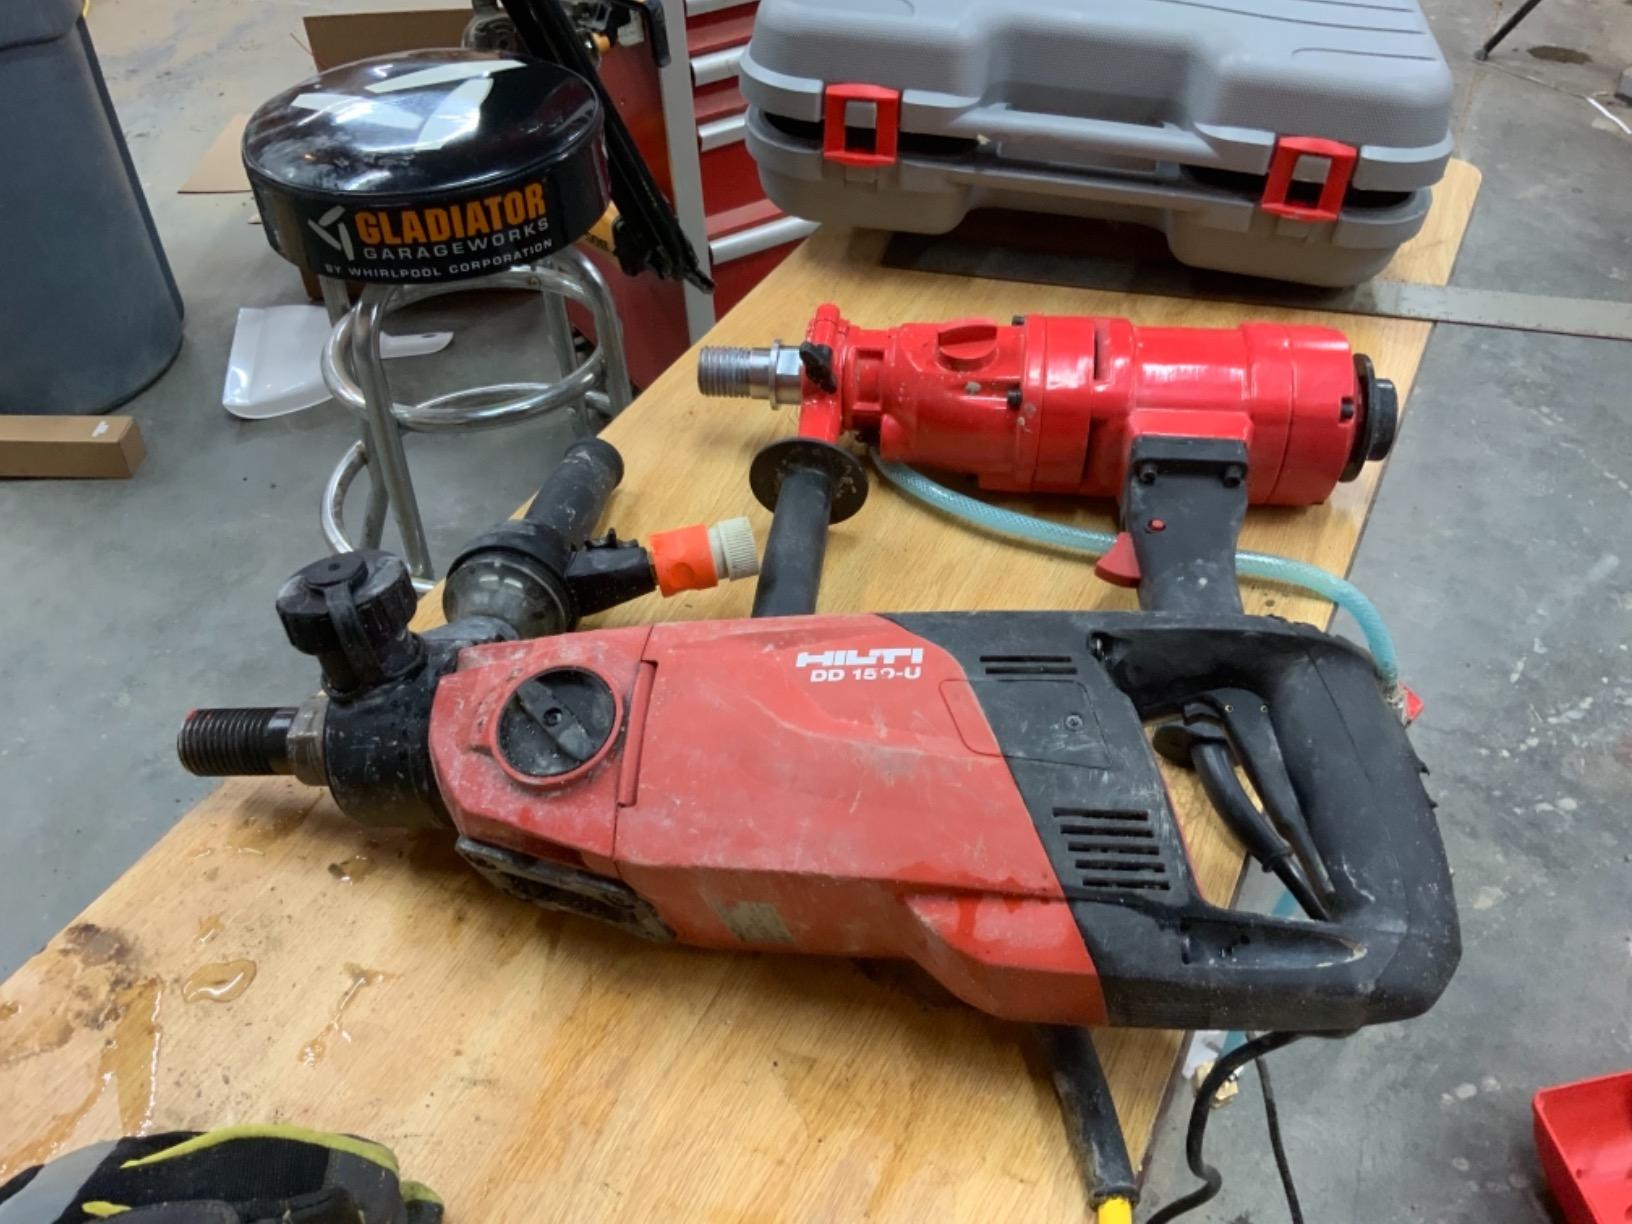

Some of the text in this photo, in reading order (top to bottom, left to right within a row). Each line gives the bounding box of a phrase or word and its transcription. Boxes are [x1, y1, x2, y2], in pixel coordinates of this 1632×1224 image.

[355, 183, 546, 245] GLADIATOR
[363, 217, 549, 260] GARAGEWORKS
[325, 239, 552, 279] BY WHIRLPOOL CORPORATION
[796, 648, 924, 667] HILTI
[810, 669, 845, 682] DD
